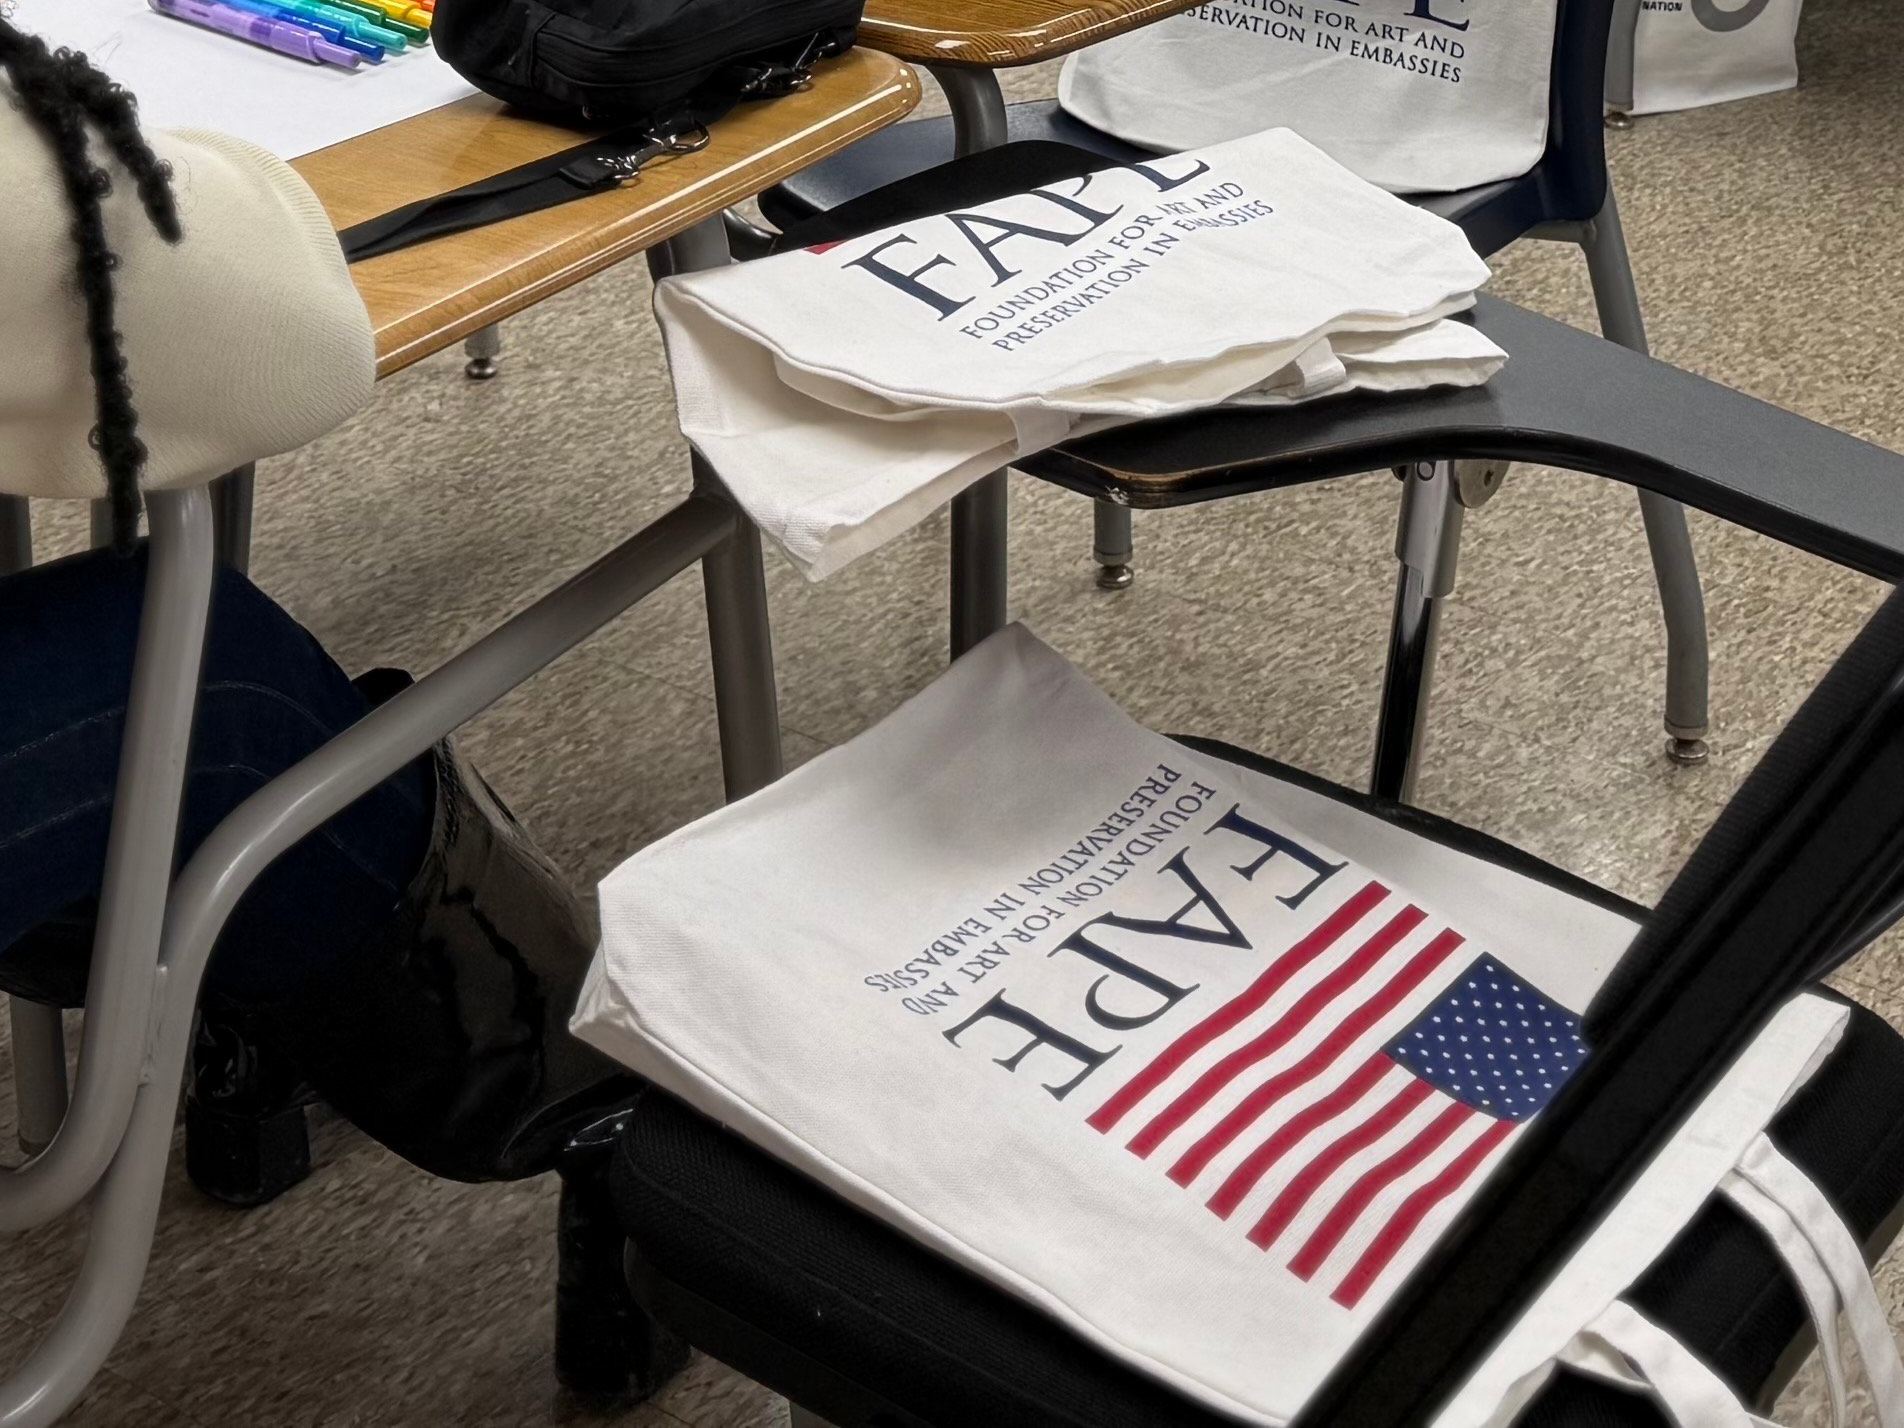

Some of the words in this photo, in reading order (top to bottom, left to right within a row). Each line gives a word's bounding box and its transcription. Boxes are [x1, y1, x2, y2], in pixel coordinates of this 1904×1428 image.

[1314, 10, 1357, 32] FOR
[1365, 24, 1409, 42] ART
[1418, 32, 1465, 59] AND
[1316, 31, 1341, 52] IN
[1350, 40, 1462, 83] EMBASSIES
[960, 248, 1117, 340] FOUNDATION
[1107, 213, 1163, 261] FOR
[1196, 182, 1244, 212] AND
[992, 259, 1150, 352] PRESERVATION
[1145, 232, 1181, 257] IN
[1018, 763, 1182, 897] PRESERVATION
[1056, 780, 1217, 908] FOUNDATION
[981, 887, 1028, 923] IN
[1006, 903, 1066, 947] FOR
[941, 802, 1350, 1102] FAPE
[969, 940, 1012, 985] ART
[902, 981, 961, 1017] AND
